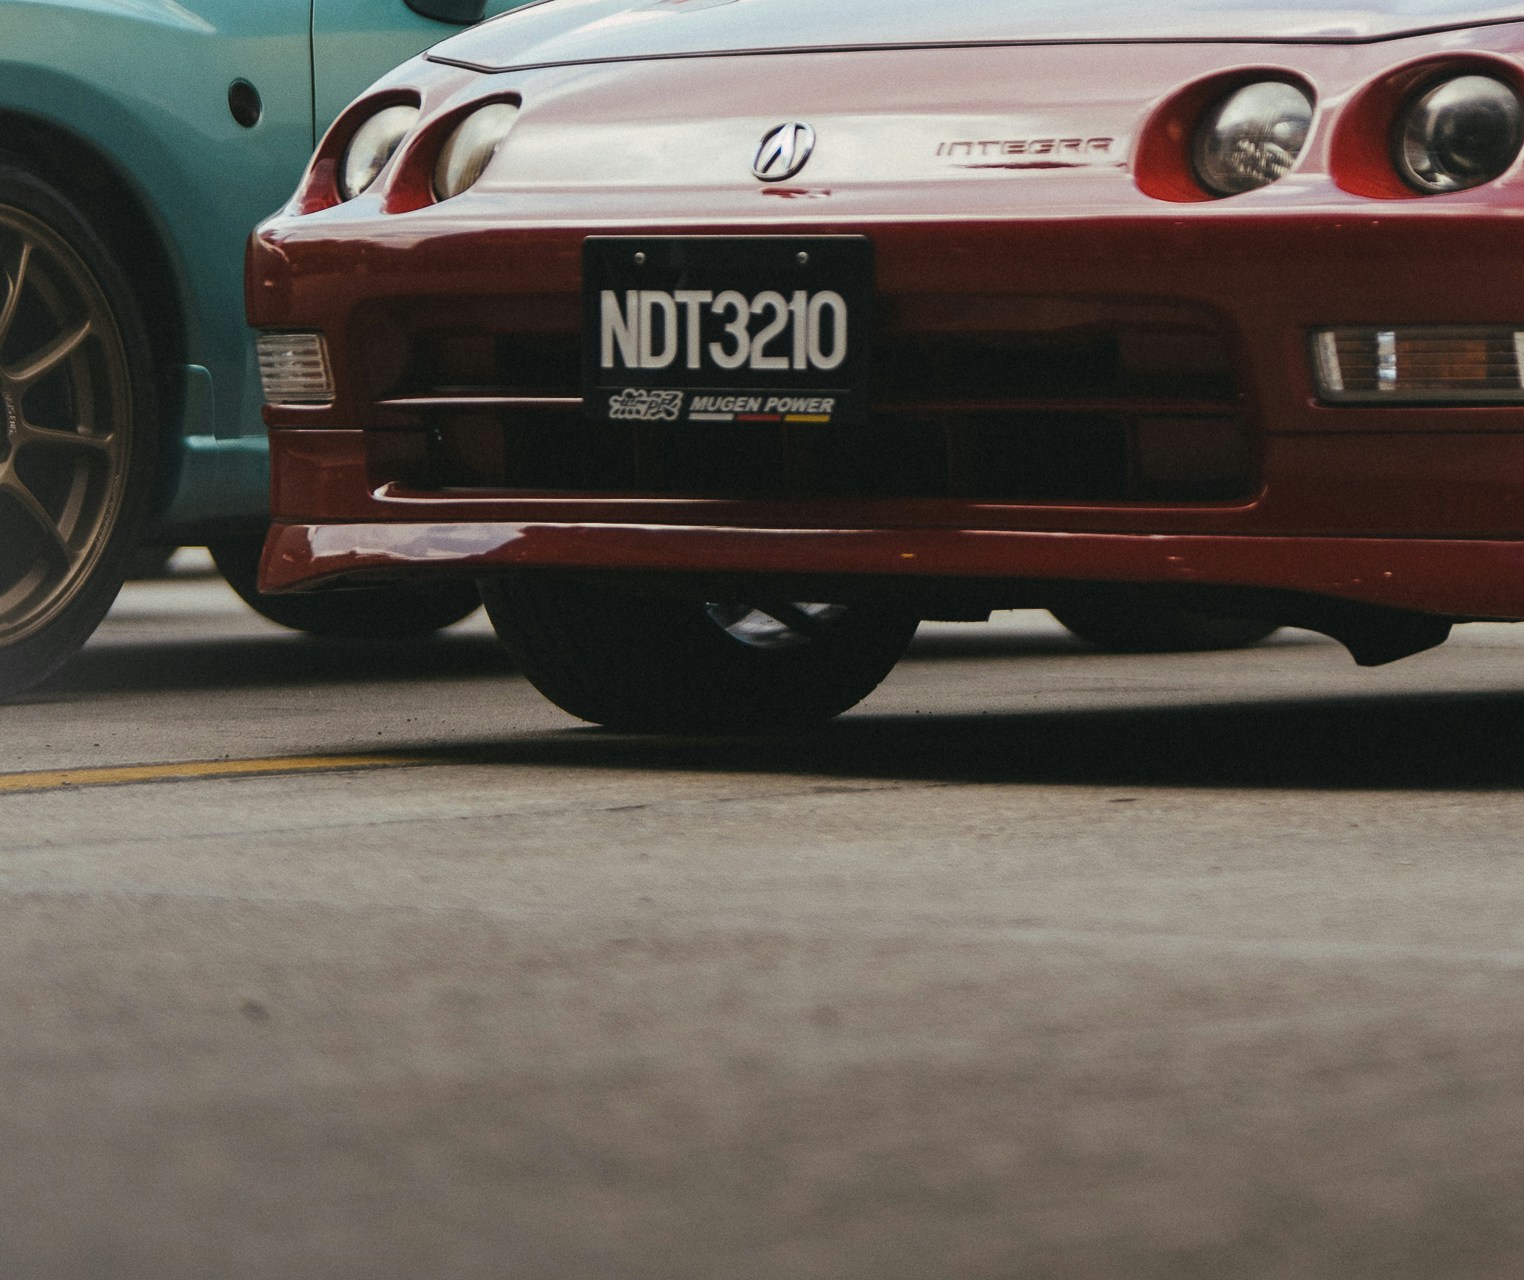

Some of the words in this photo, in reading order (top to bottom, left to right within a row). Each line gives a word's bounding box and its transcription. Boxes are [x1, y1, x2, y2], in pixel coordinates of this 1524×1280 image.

[935, 136, 1114, 157] INTEGRA
[600, 289, 848, 370] NDT3210
[689, 395, 763, 412] MUGEN
[763, 397, 836, 413] POWER
